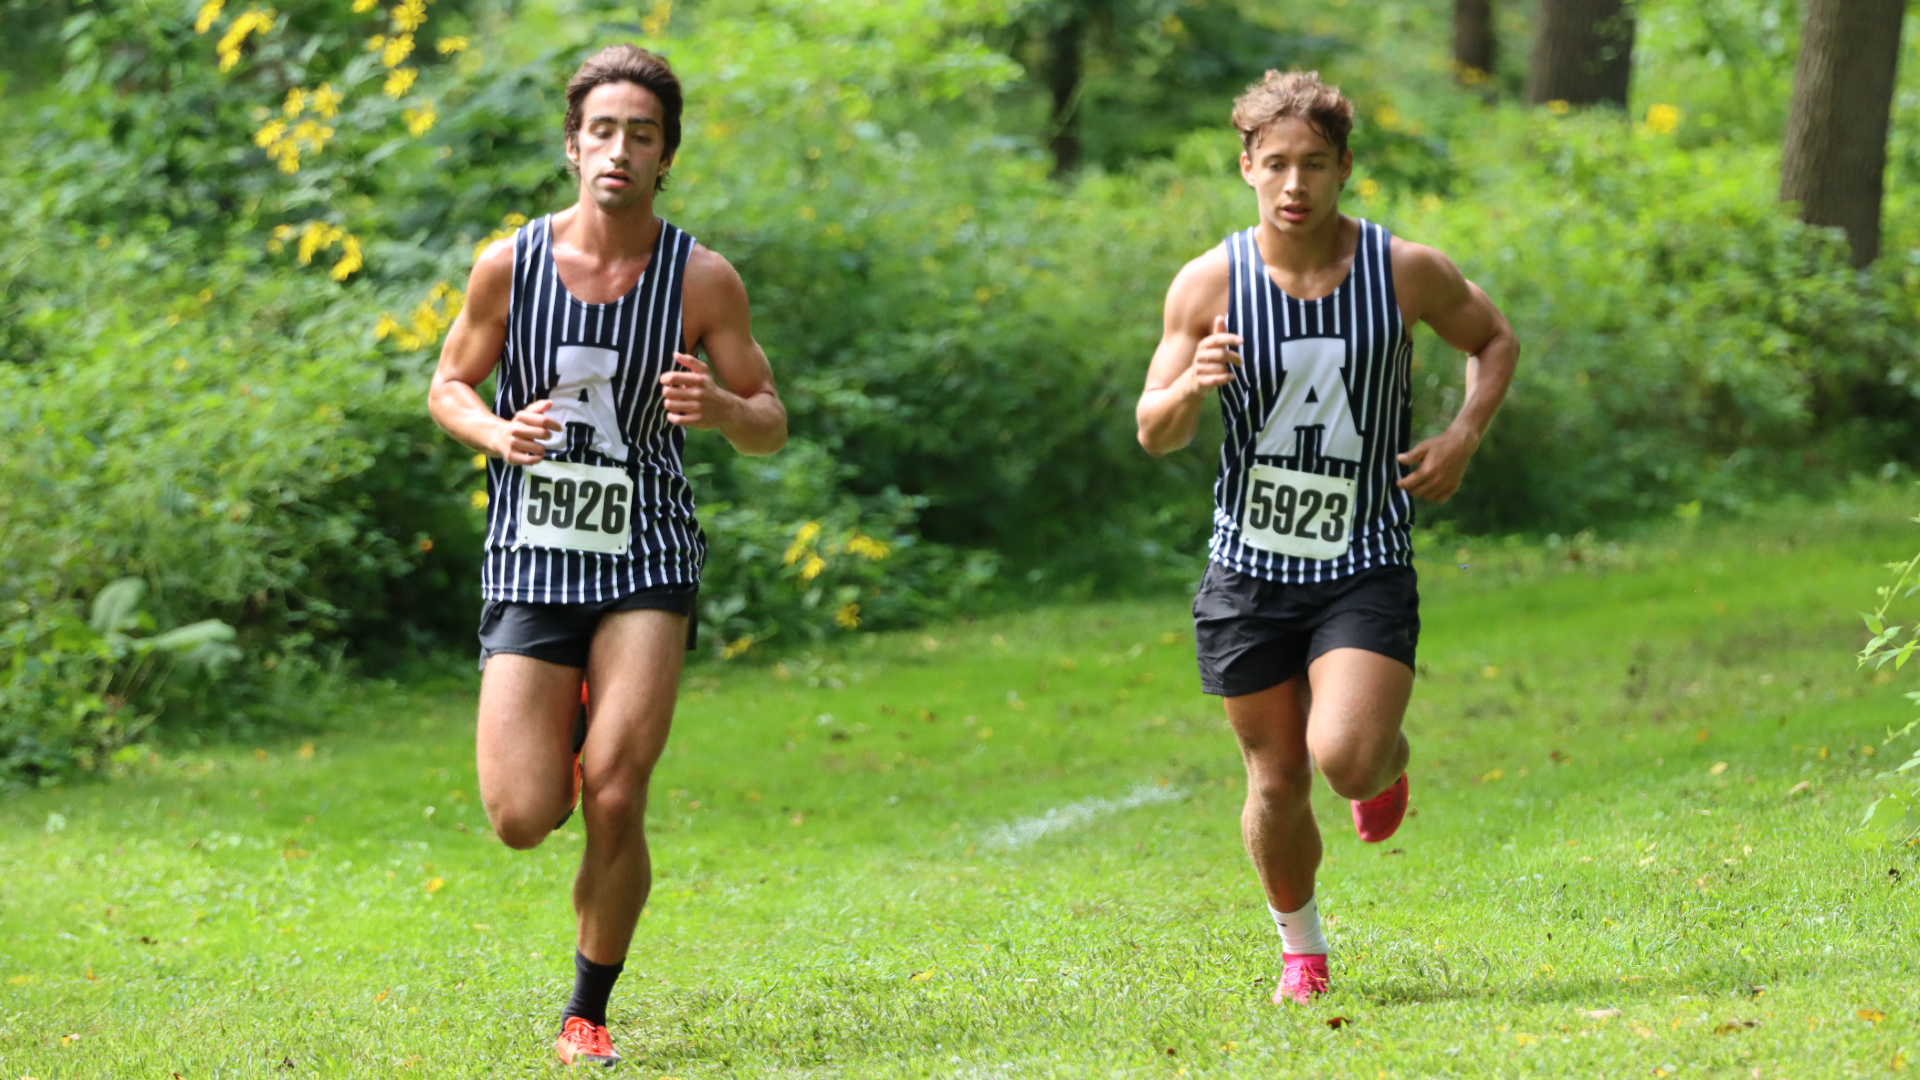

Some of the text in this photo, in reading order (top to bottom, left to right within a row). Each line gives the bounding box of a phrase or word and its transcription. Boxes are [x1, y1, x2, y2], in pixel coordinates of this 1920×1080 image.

[534, 345, 629, 462] A
[1255, 337, 1364, 463] A
[526, 474, 628, 535] 5926
[1249, 479, 1348, 543] 5923
